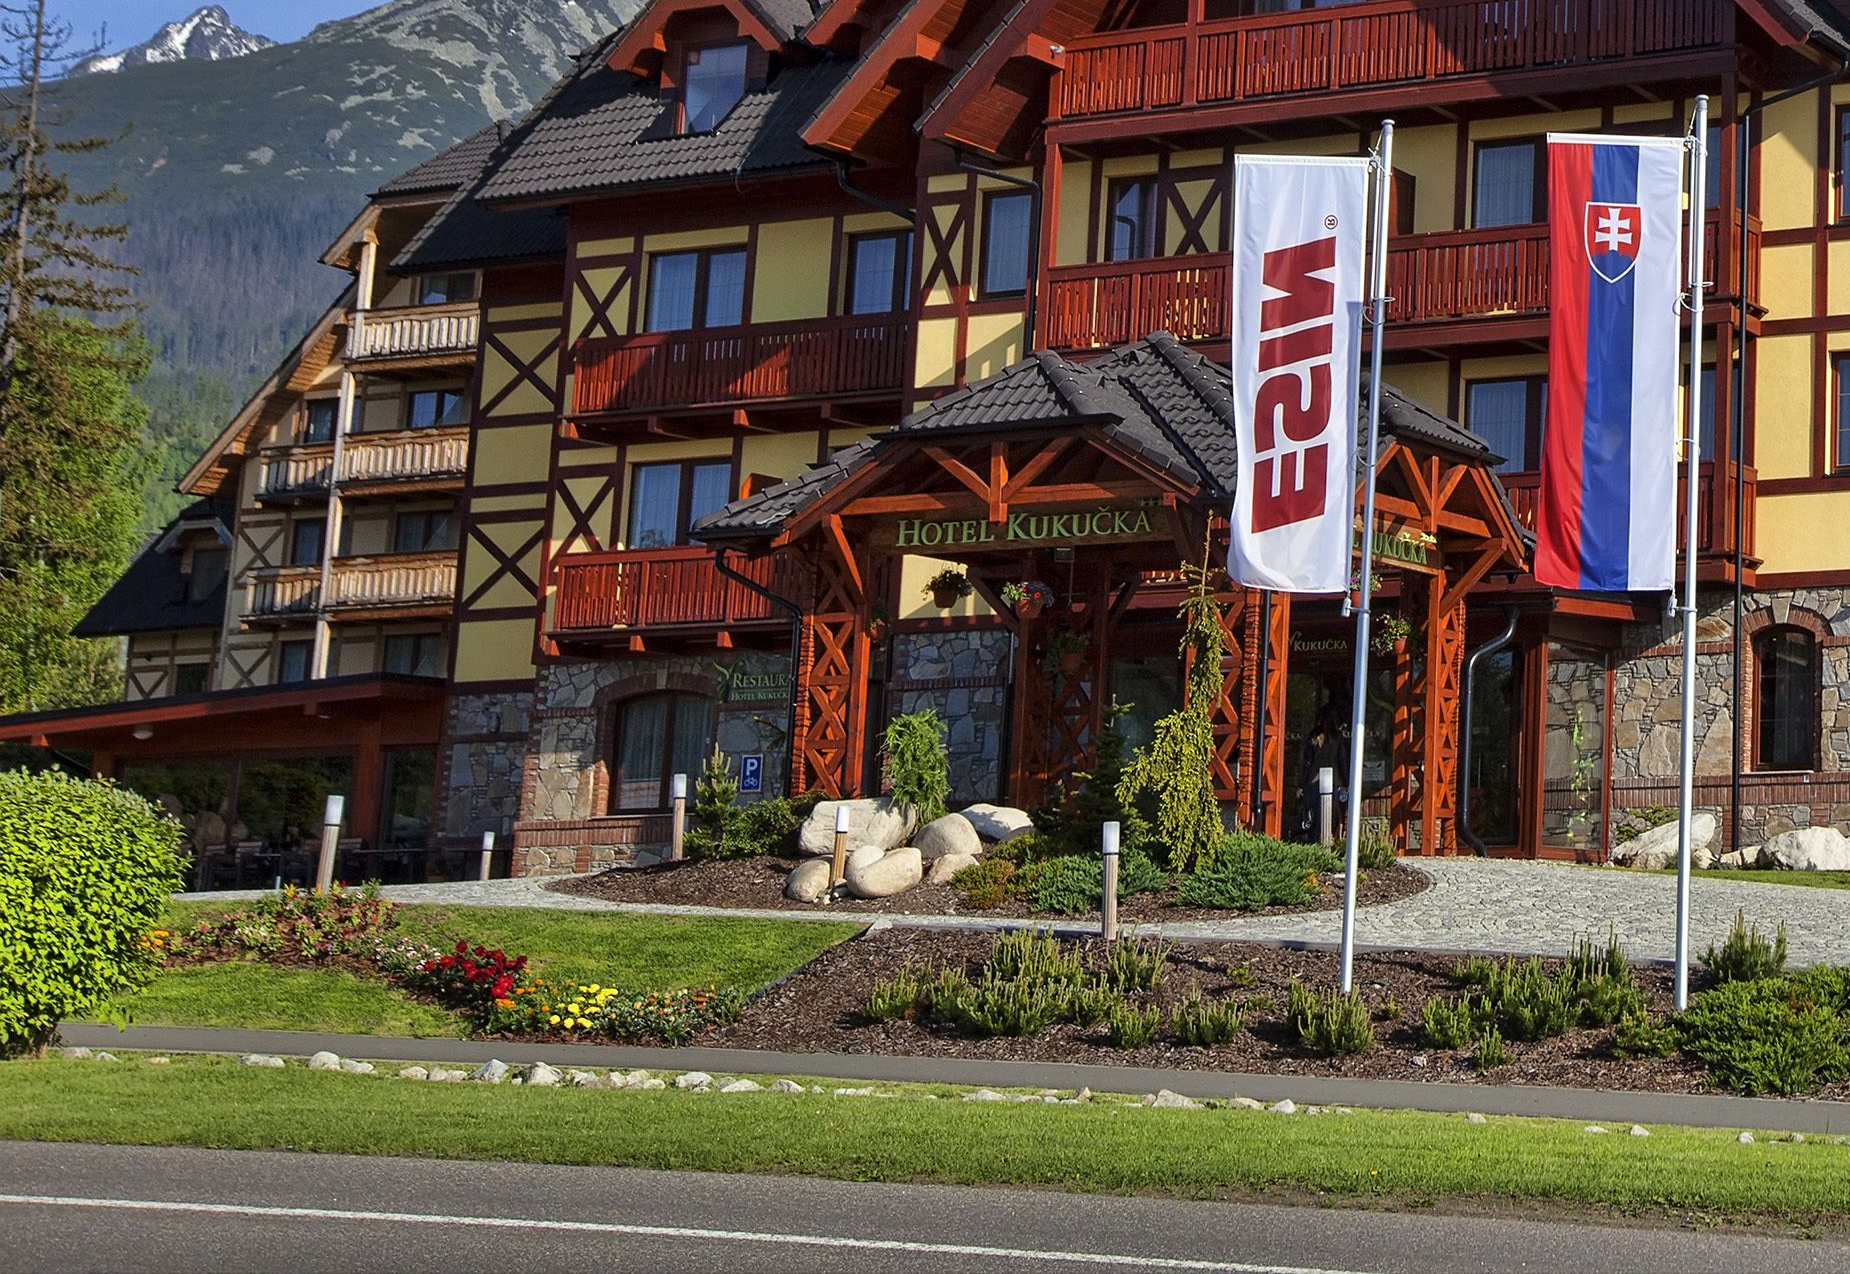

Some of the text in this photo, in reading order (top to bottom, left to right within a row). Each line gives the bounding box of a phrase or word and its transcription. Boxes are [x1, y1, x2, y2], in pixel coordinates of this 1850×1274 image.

[896, 506, 1152, 547] HOTEL KUKUČKA
[1294, 637, 1347, 652] KUKUČKA
[745, 758, 758, 776] P
